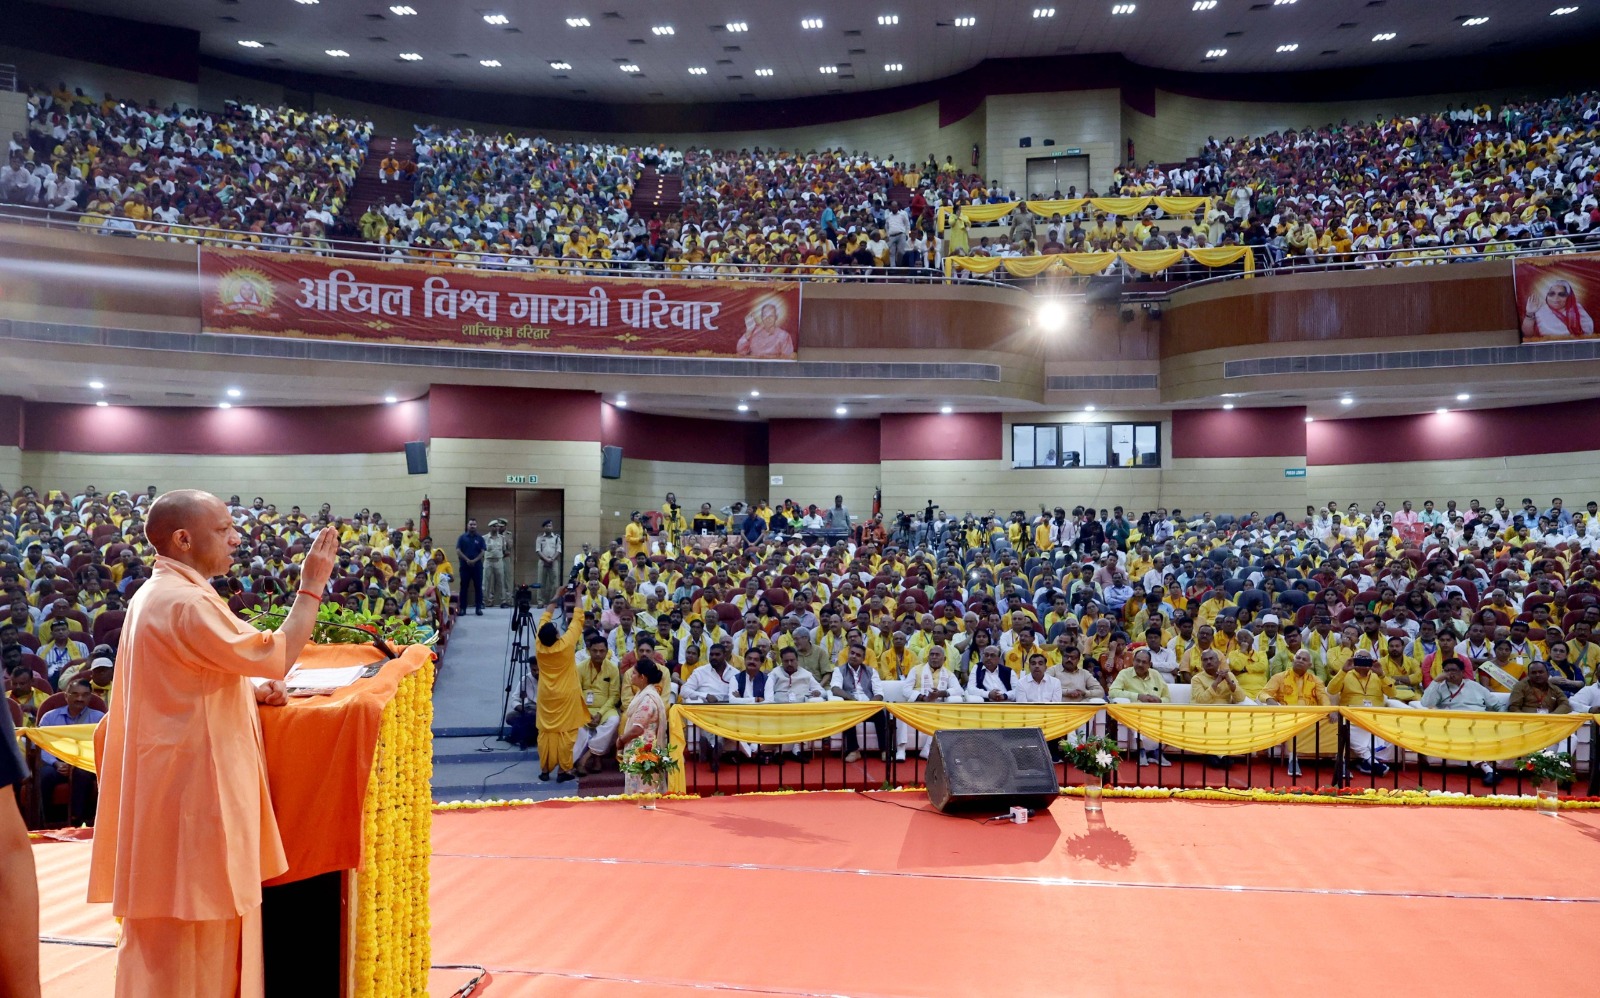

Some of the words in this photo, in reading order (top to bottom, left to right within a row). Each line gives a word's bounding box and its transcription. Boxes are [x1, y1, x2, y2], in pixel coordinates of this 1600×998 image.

[295, 269, 414, 316] अखिल
[421, 276, 500, 322] विश्व
[507, 286, 610, 327] गायत्री
[618, 288, 722, 331] परिवार
[516, 323, 551, 340] हरिद्वार
[506, 475, 525, 483] EXIT
